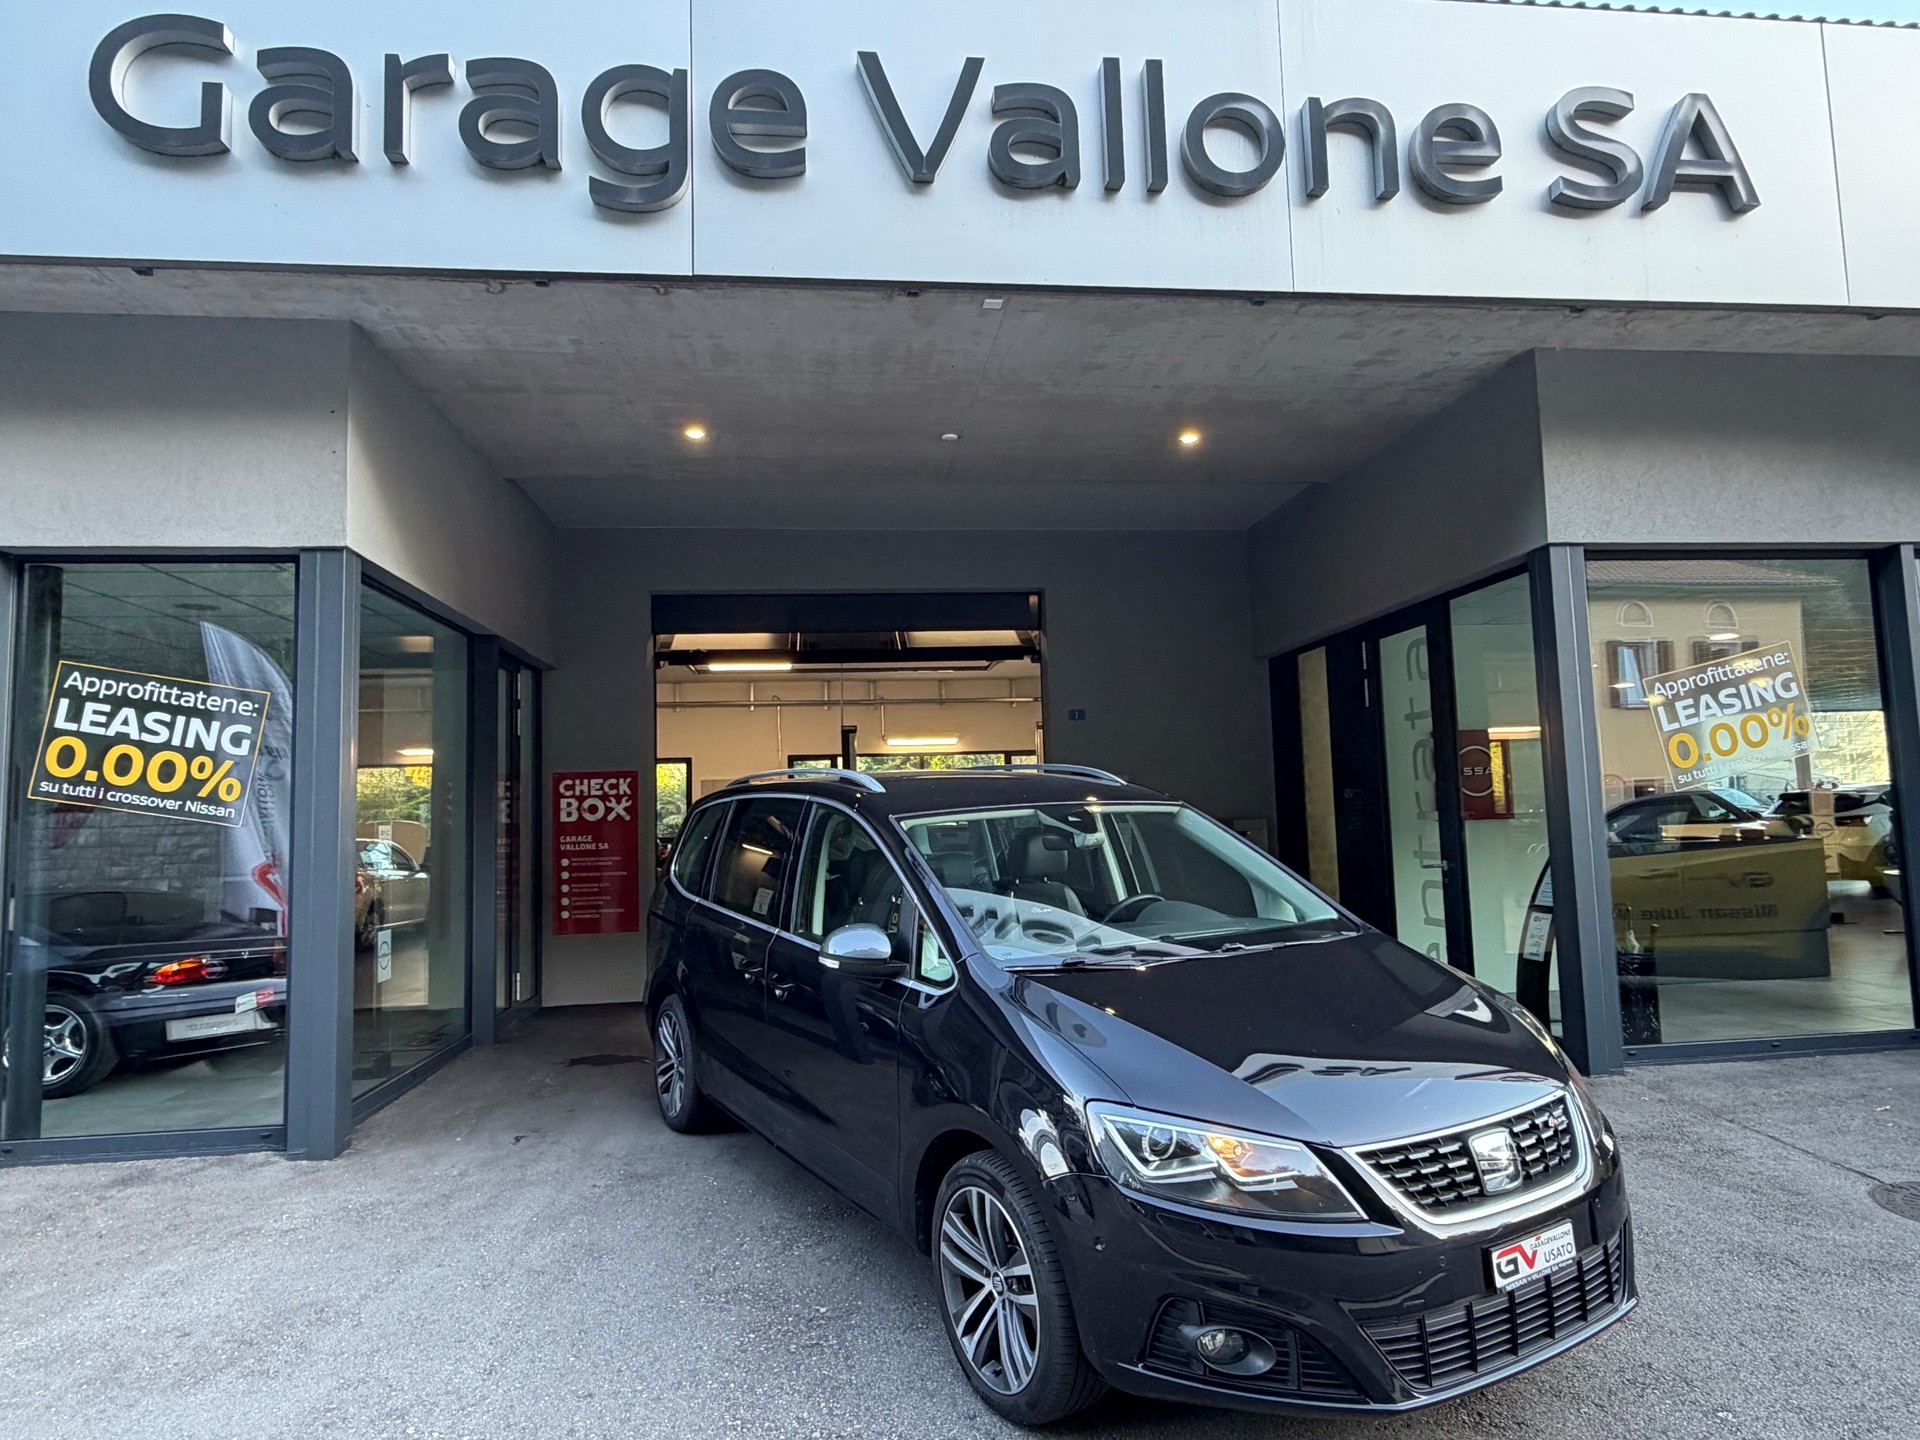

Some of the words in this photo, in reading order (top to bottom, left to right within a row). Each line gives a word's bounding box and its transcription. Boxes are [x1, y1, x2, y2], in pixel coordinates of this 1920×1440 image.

[88, 13, 809, 214] Garage
[856, 50, 1504, 205] Vallone
[1546, 84, 1762, 216] SA
[63, 671, 259, 717] Approfittatene:
[1654, 652, 1790, 699] Approfittatene:
[1657, 672, 1799, 732] LEASING
[54, 698, 253, 756] LEASING
[1668, 703, 1810, 769] 0.00%
[45, 735, 242, 802] 0.00%
[559, 778, 632, 796] CHECK
[1677, 772, 1693, 784] su
[38, 780, 59, 793] su
[62, 783, 97, 799] tutti
[99, 787, 104, 800] i
[106, 789, 183, 811] crossover
[185, 799, 236, 818] Nissan
[559, 796, 632, 822] BOX
[560, 835, 593, 843] GARAGE
[560, 843, 597, 851] VALLONE
[598, 842, 609, 850] SA
[1544, 1242, 1574, 1263] USATO
